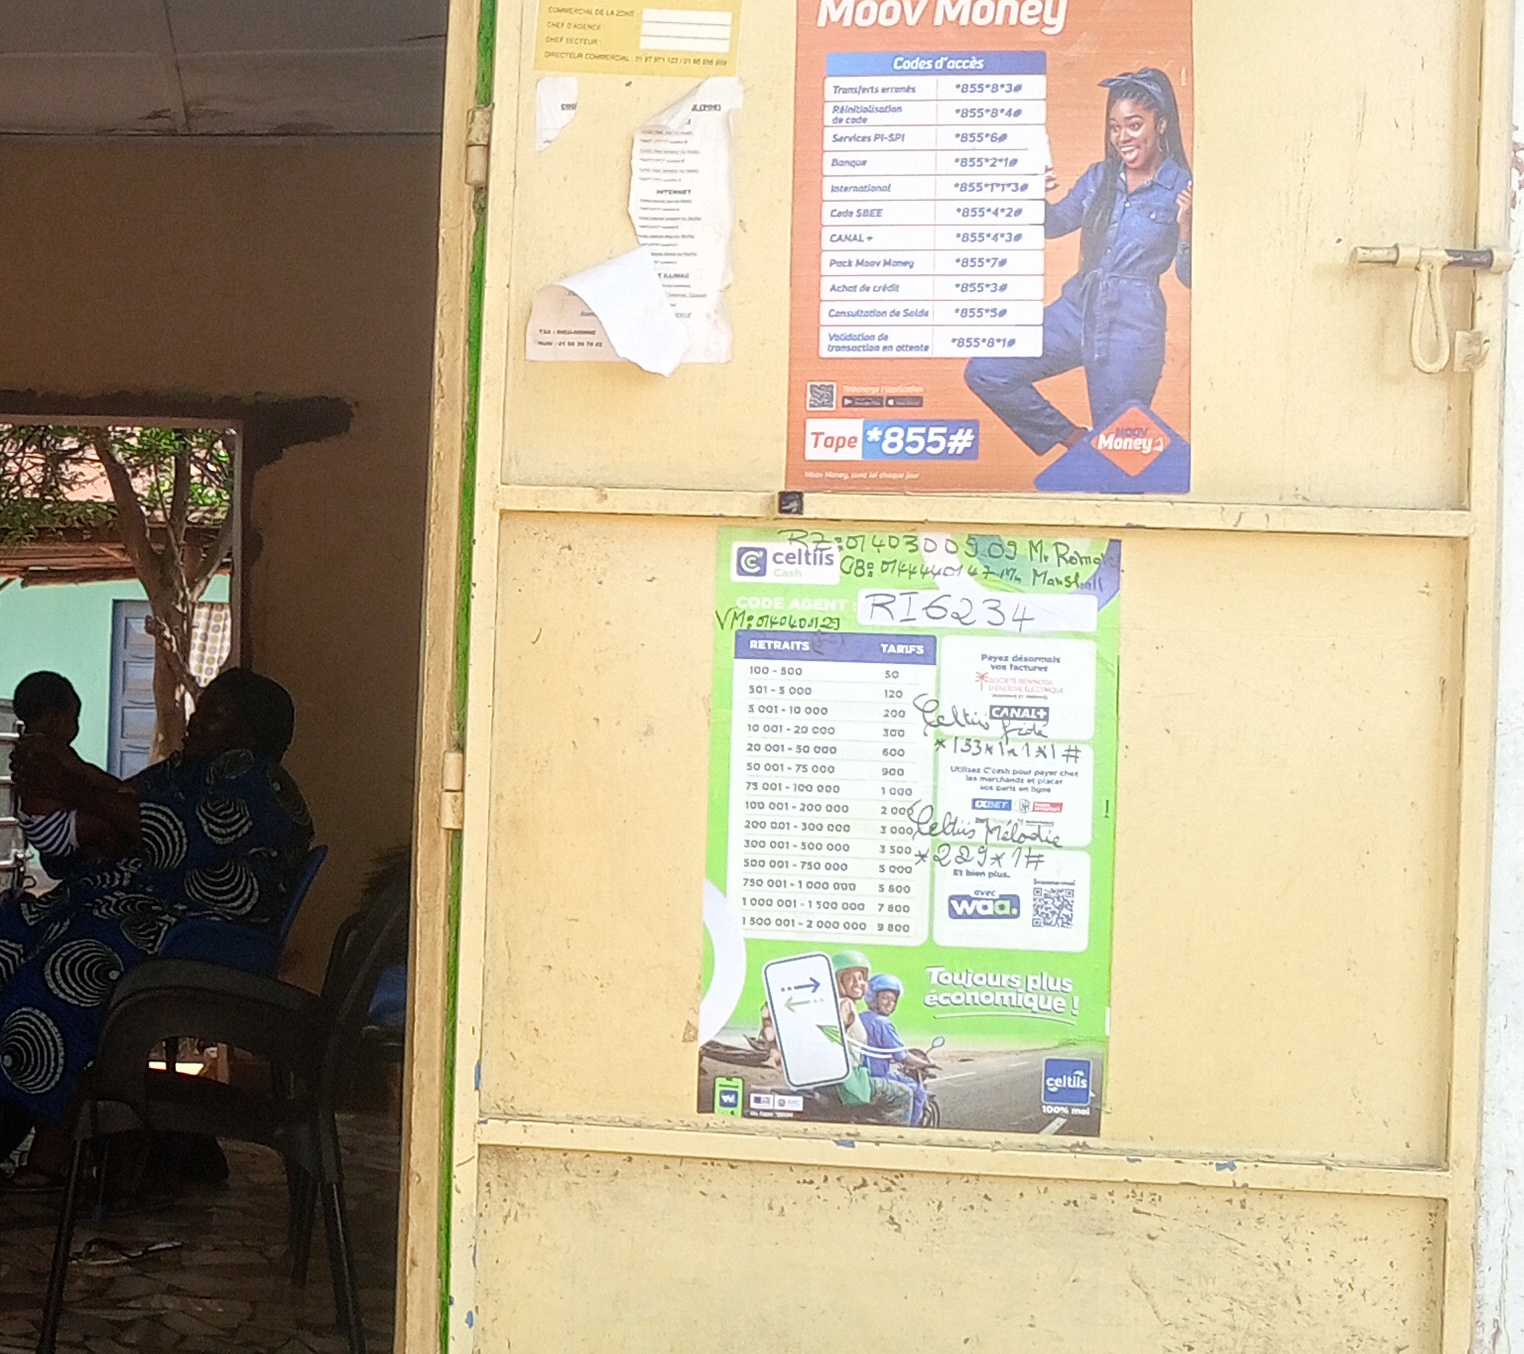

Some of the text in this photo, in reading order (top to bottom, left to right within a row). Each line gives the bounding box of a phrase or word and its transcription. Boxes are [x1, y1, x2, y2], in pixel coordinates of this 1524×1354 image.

[893, 55, 985, 71] Codes d'accès
[832, 85, 879, 95] Transferts
[832, 133, 871, 143] Services
[831, 158, 867, 168] Banque
[831, 183, 891, 193] International
[829, 233, 864, 243] CANAL
[829, 259, 914, 269] Pack Moov Money
[828, 309, 887, 318] Consultation
[828, 332, 876, 342] Validation
[827, 344, 880, 353] transaction
[810, 432, 858, 452] Tape
[1097, 434, 1153, 455] Money
[772, 549, 834, 566] celtiis
[774, 568, 802, 578] Cash
[736, 596, 848, 611] CODE AGENT
[749, 640, 924, 654] RETRAITS TARIFS
[981, 654, 1061, 663] Payez désormais
[749, 666, 802, 676] 100 500
[1009, 663, 1048, 671] factures
[884, 671, 899, 679] 50
[749, 685, 768, 694] 501
[789, 687, 812, 695] 000
[884, 689, 903, 698] 120
[758, 705, 828, 715] 001 10 000
[882, 709, 906, 718] 200
[991, 707, 1047, 719] CANAL+
[747, 724, 835, 735] 10 001 20 000
[882, 728, 905, 737] 300
[746, 742, 837, 755] 20 001 50 000
[882, 748, 905, 757] 600
[746, 762, 760, 771] 50
[764, 763, 784, 772] 001
[811, 765, 835, 774] 000
[745, 800, 849, 813] 100 001 200 000
[924, 967, 1073, 994] Toujours plus
[924, 989, 1066, 1013] économique
[1041, 1104, 1070, 1116] 100%
